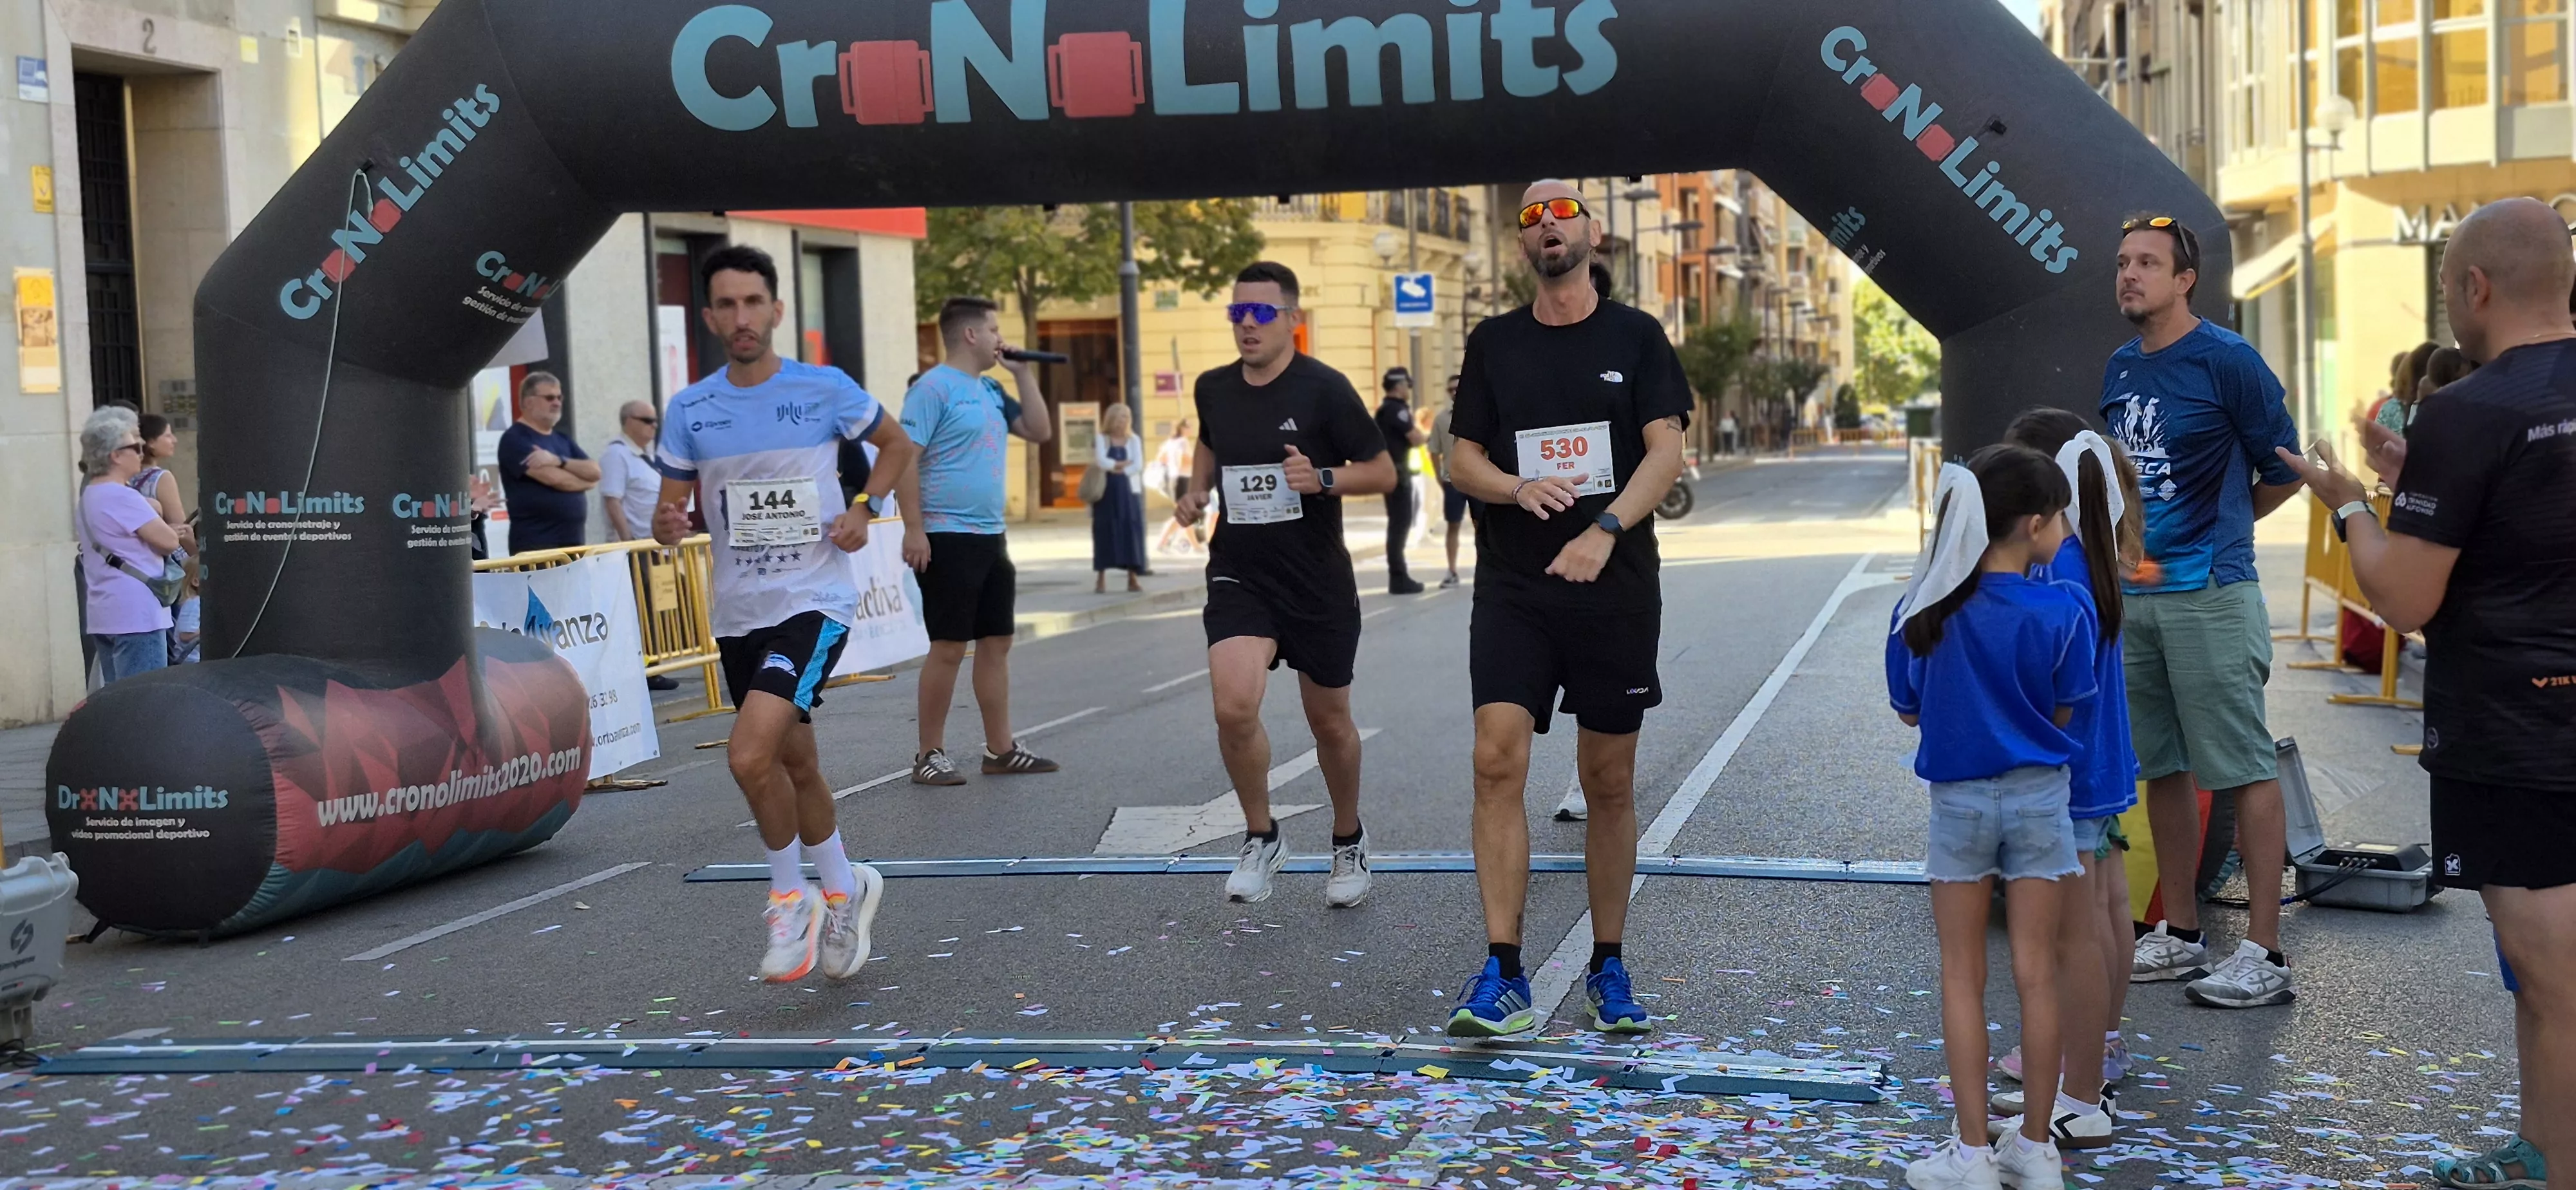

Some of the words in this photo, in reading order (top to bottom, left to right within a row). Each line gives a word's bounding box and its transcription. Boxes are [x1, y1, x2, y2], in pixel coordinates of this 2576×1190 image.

[142, 18, 157, 54] 2
[2528, 423, 2555, 442] Más
[1540, 436, 1589, 460] 530
[1557, 461, 1575, 470] FER
[1240, 474, 1277, 493] 129
[750, 489, 797, 510] 144
[765, 510, 806, 520] ANTONIO
[227, 520, 253, 529] Servicio
[255, 520, 266, 529] de
[411, 524, 441, 534] Servicio
[442, 524, 451, 533] de
[224, 533, 249, 542] gestión
[251, 532, 261, 541] de
[299, 531, 352, 542] deportivos
[407, 538, 437, 548] gestión
[439, 538, 447, 547] de
[318, 746, 581, 827] www.cronolimits2020.com
[86, 817, 119, 827] Servicio
[120, 817, 133, 827] de
[135, 817, 175, 828] imagen
[177, 817, 185, 827] y
[95, 829, 154, 841] promocional
[156, 828, 210, 840] deportivo
